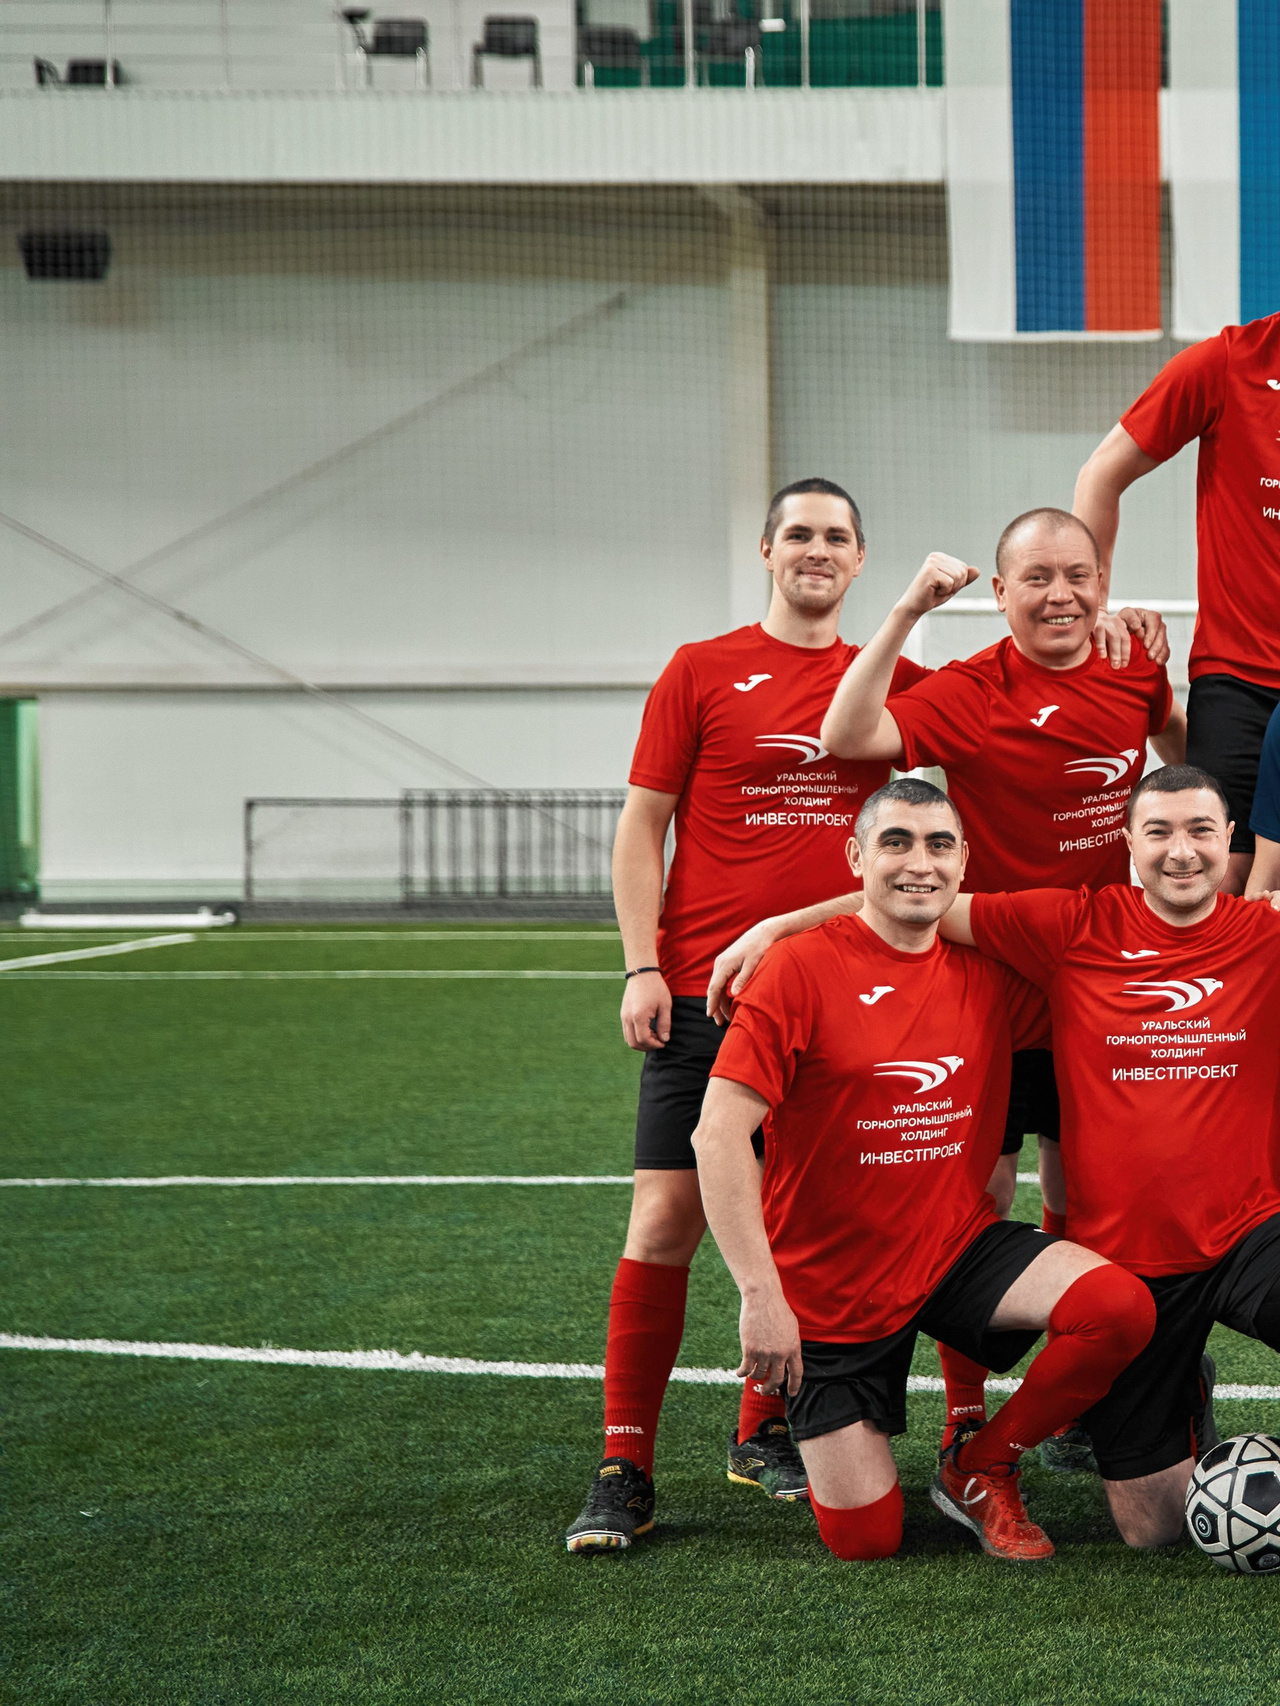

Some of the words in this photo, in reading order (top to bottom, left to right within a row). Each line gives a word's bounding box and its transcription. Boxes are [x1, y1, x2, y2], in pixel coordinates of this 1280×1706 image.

[776, 771, 837, 782] УРАЛЬСКИЙ
[784, 797, 832, 807] ХОЛДИНГ
[1082, 785, 1132, 805] УРАЛЬСКИЙ
[745, 812, 853, 826] ИНВЕСТПРОЕКТ
[1091, 811, 1125, 829] ХОЛДИНГ
[1141, 1016, 1211, 1031] УРАЛЬСКИЙ
[1106, 1029, 1246, 1045] ГОРНОПРОМЫШЛЕННЫЙ
[1151, 1047, 1207, 1059] ХОЛДИНГ
[1112, 1064, 1239, 1081] ИНВЕСТПРОЕКТ
[892, 1097, 953, 1114] УРАЛЬСКИЙ
[900, 1127, 949, 1141] ХОЛДИНГ
[605, 1425, 644, 1436] Joma
